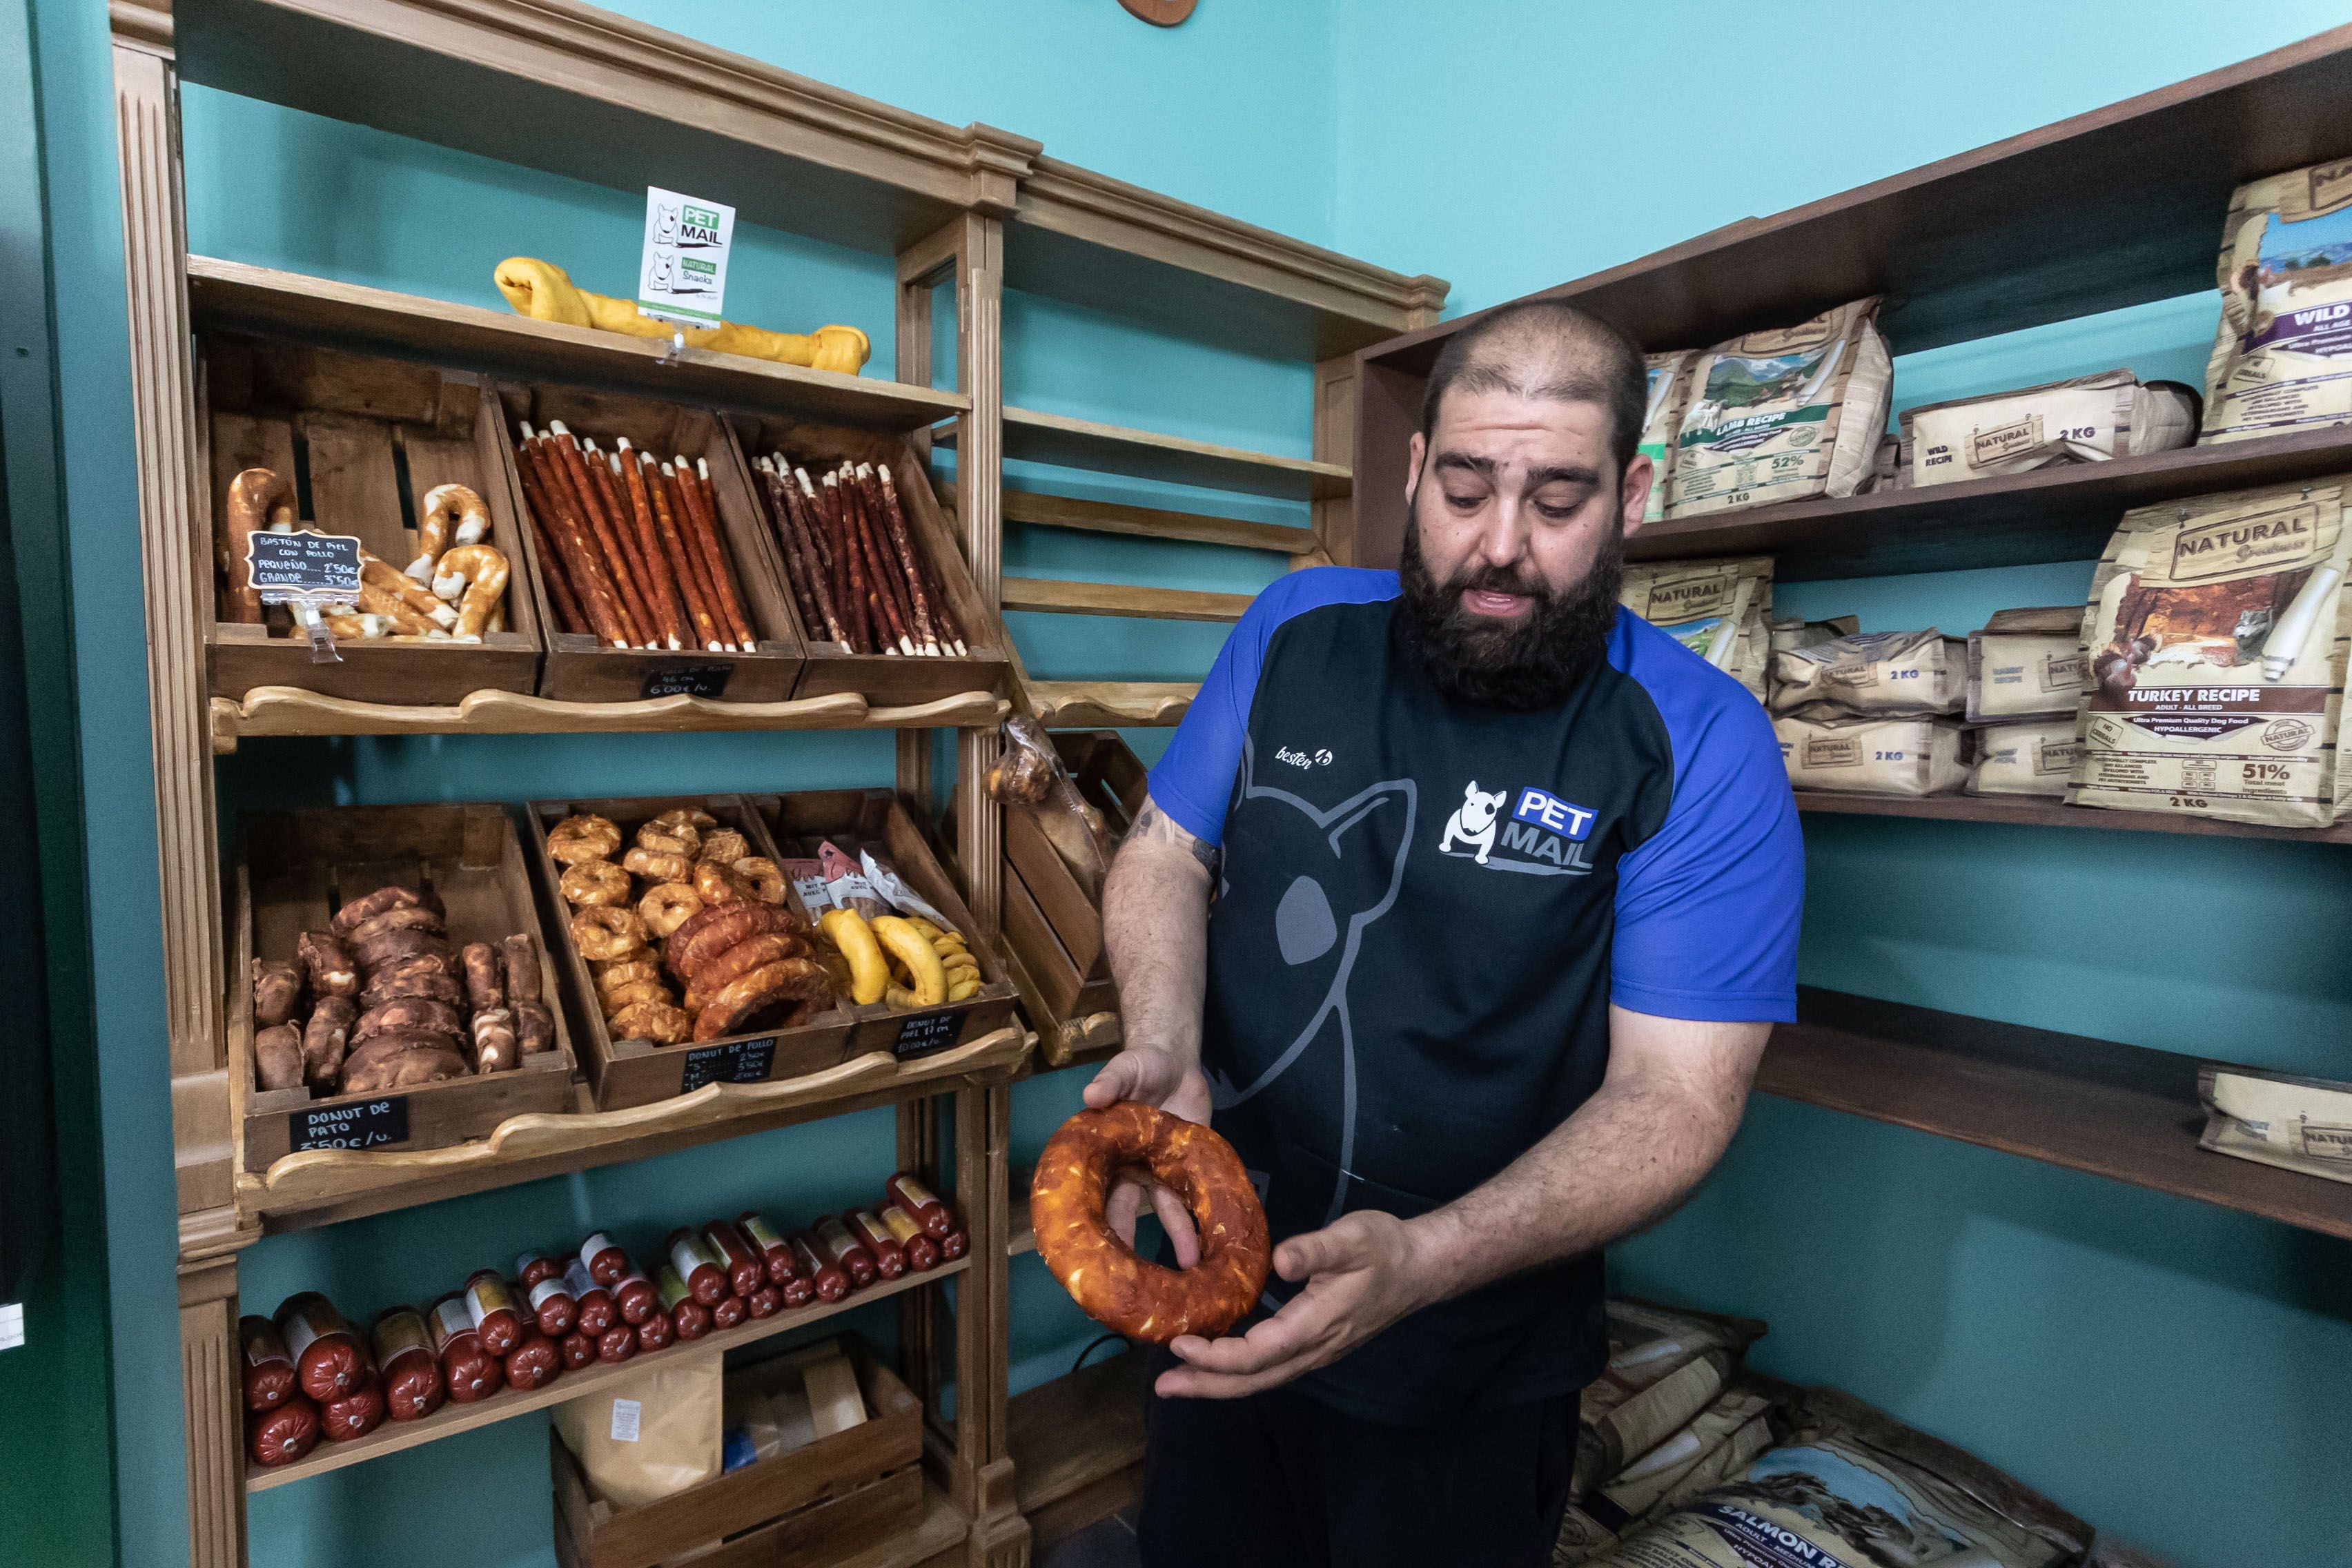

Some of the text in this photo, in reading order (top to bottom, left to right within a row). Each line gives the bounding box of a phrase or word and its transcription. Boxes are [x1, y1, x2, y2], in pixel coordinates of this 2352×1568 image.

[685, 208, 717, 228] PET
[681, 224, 723, 244] MAIL
[682, 258, 715, 273] NATURAL
[682, 270, 712, 284] Snacks
[2294, 304, 2350, 326] WILD
[1716, 412, 1786, 436] LAMB RECIPE
[1977, 427, 2029, 450] NATURAL
[2071, 427, 2096, 440] KG
[1771, 455, 1804, 469] 52%
[1728, 495, 1734, 504] 2
[1736, 492, 1750, 502] KG
[260, 537, 302, 547] BASTÓN
[307, 541, 320, 549] DE
[2179, 518, 2309, 558] NATURAL
[1652, 584, 1721, 603] NATURAL
[1890, 670, 1898, 680] 2
[1901, 669, 1919, 679] KG
[2128, 689, 2260, 702] TURKEY RECIPE
[2154, 725, 2222, 734] HYPOALLERGENIC
[2264, 728, 2311, 743] NATURAL
[1275, 746, 1312, 770] besten
[1810, 743, 1903, 761] NATURAL 2 KG
[2243, 763, 2290, 780] 51%
[2169, 796, 2208, 809] 2 KG
[1518, 791, 1593, 836] PET
[1500, 821, 1594, 869] MAIL
[689, 1048, 723, 1061] DONUT
[747, 1039, 774, 1050] POLLO
[308, 1106, 364, 1125] DONUT
[308, 1122, 351, 1138] PATO
[1718, 1505, 1817, 1560] SALMON
[1735, 1522, 1767, 1542] ADULT
